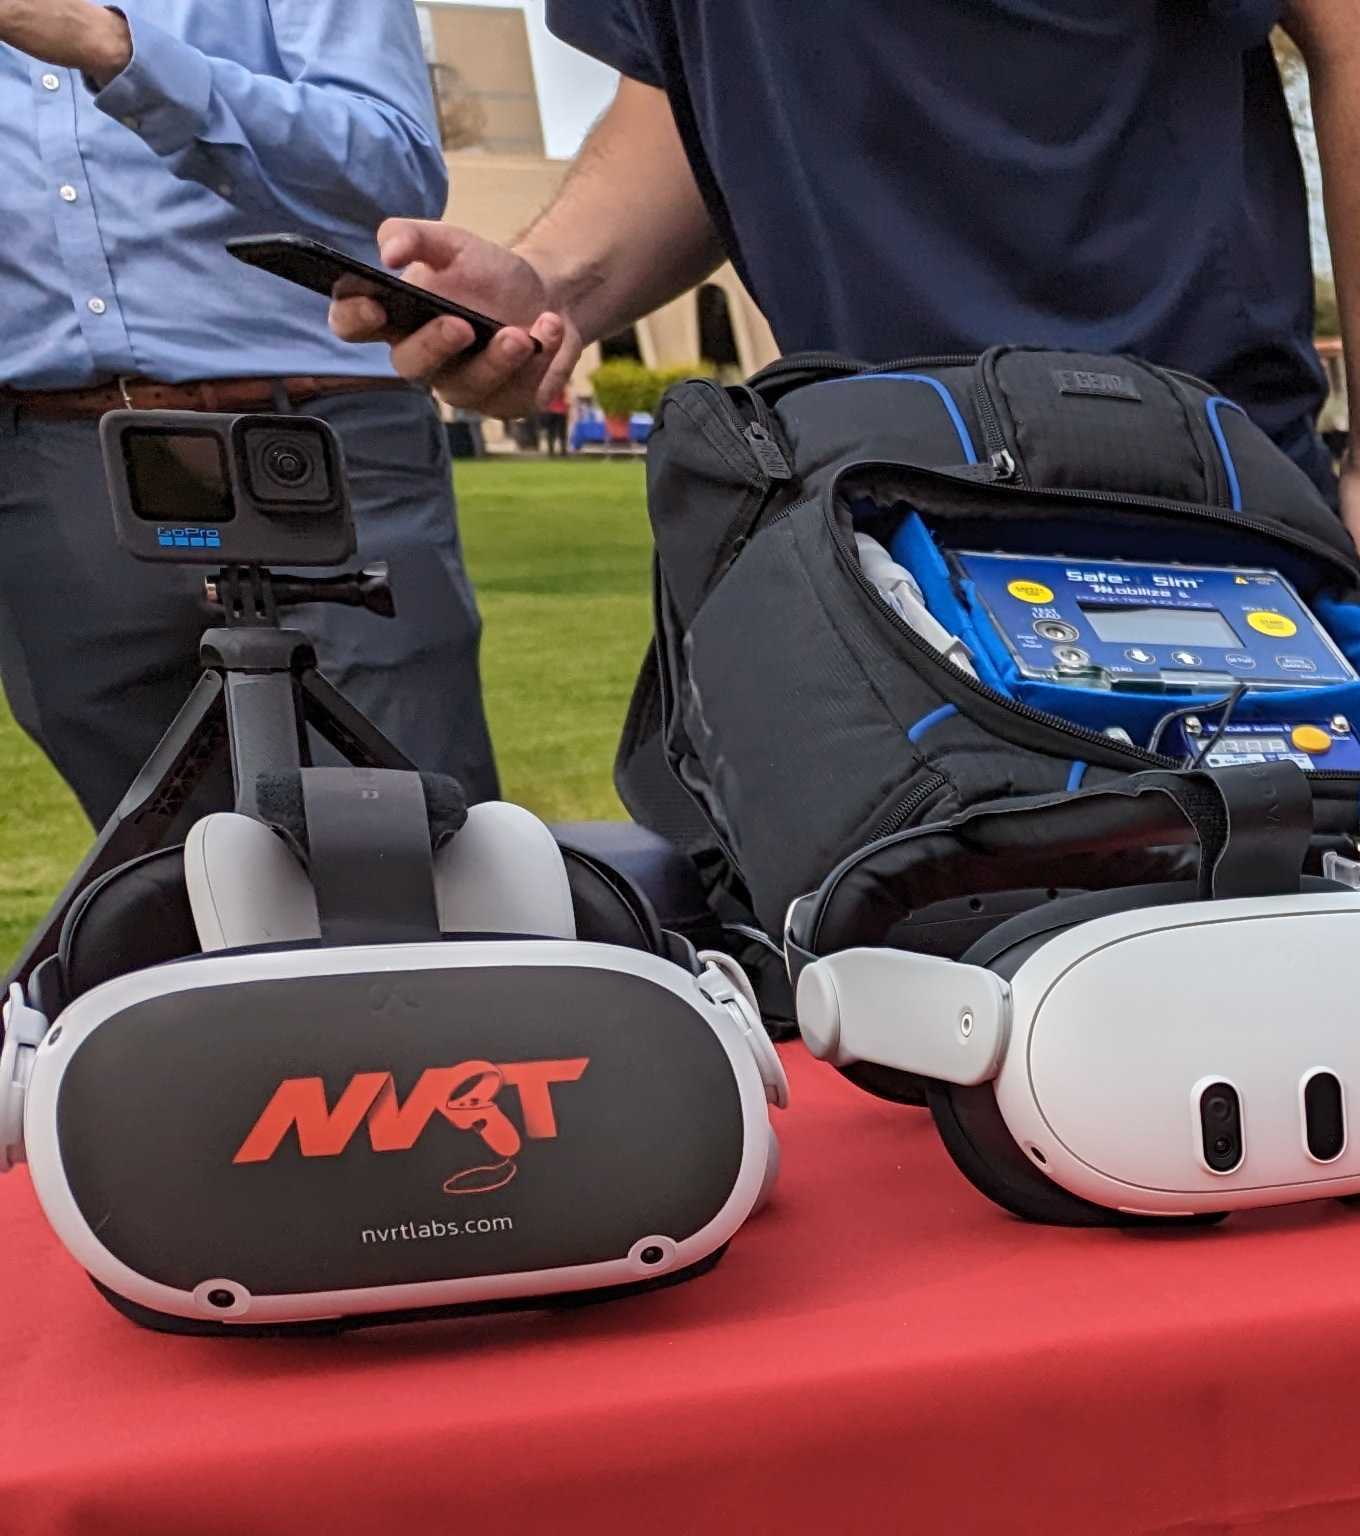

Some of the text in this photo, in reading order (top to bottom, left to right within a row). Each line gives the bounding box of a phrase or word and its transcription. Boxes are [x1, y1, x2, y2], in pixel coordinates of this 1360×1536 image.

[157, 527, 219, 537] GoPro
[232, 1057, 590, 1163] NVRT
[361, 1215, 514, 1244] nvrtlabs.com
